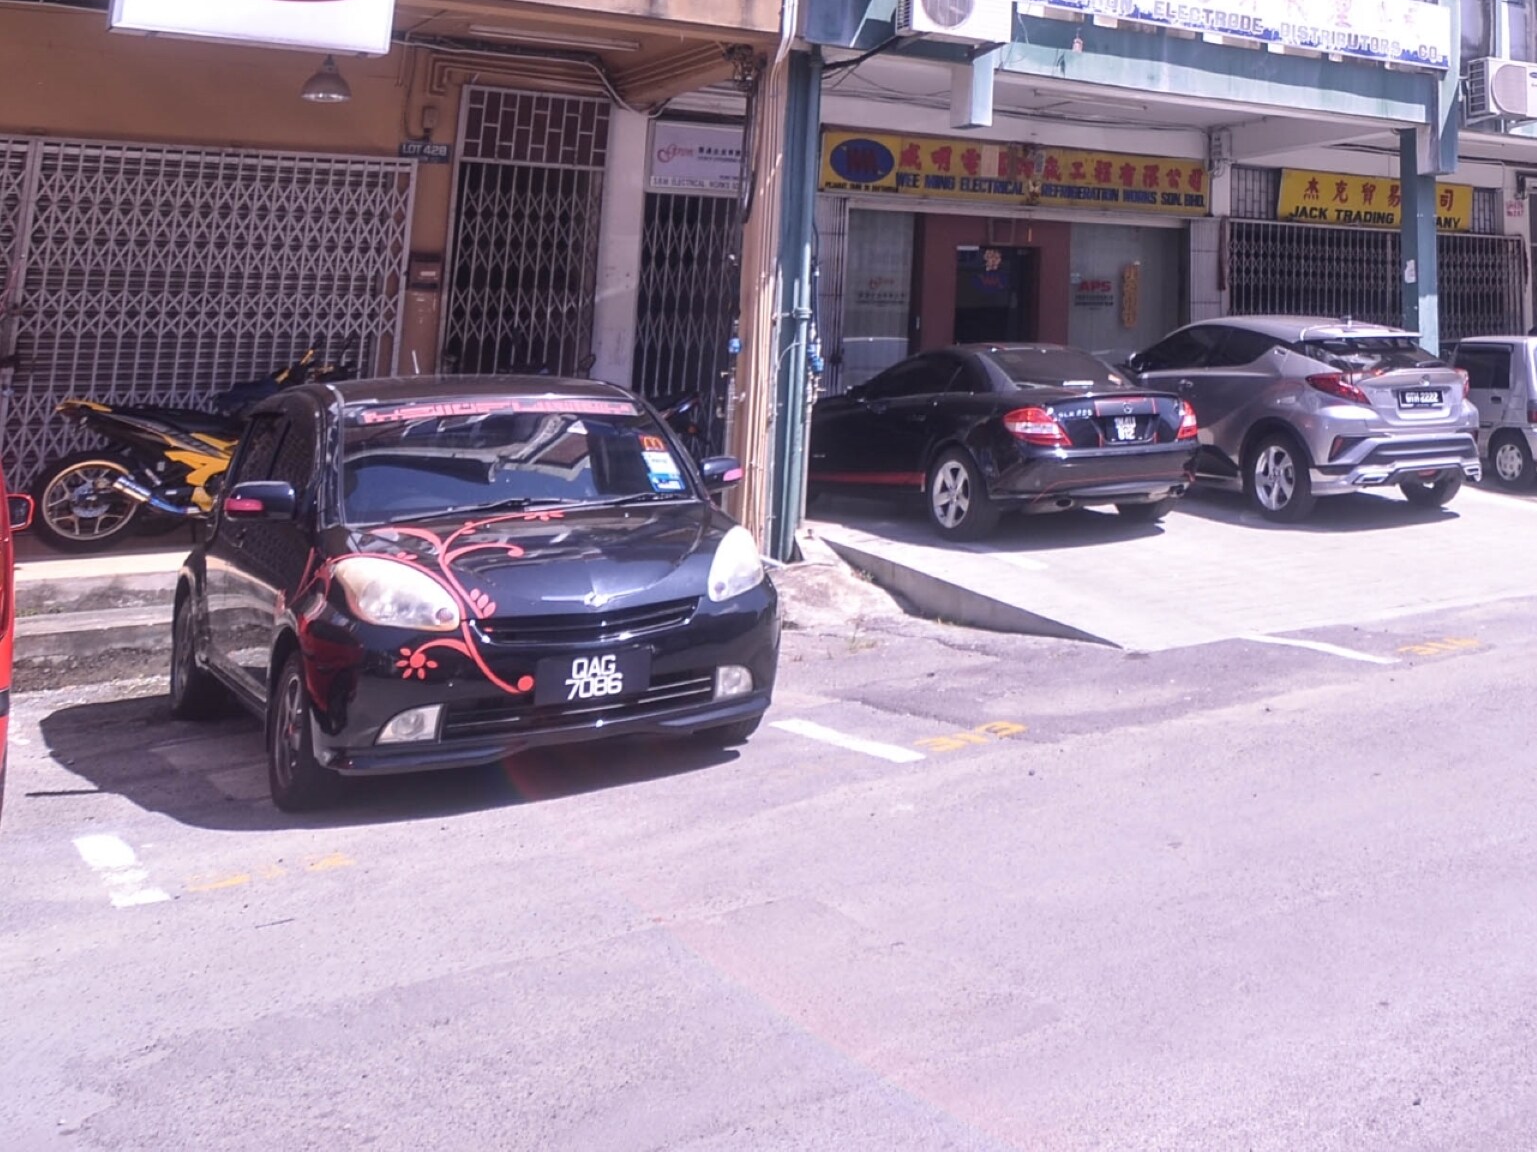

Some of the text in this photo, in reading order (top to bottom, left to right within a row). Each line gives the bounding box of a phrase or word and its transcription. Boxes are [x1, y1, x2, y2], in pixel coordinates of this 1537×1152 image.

[1153, 0, 1264, 35] ELECTRODE
[1280, 22, 1401, 57] DISTRIBUTORS
[402, 144, 422, 154] LOT
[896, 172, 920, 189] WEE
[960, 176, 1025, 196] ELECTRICAL
[1041, 182, 1120, 203] REFRIGERATION
[1289, 205, 1395, 225] JACK TRADING
[571, 653, 617, 680] QAG
[564, 671, 623, 701] 7086
